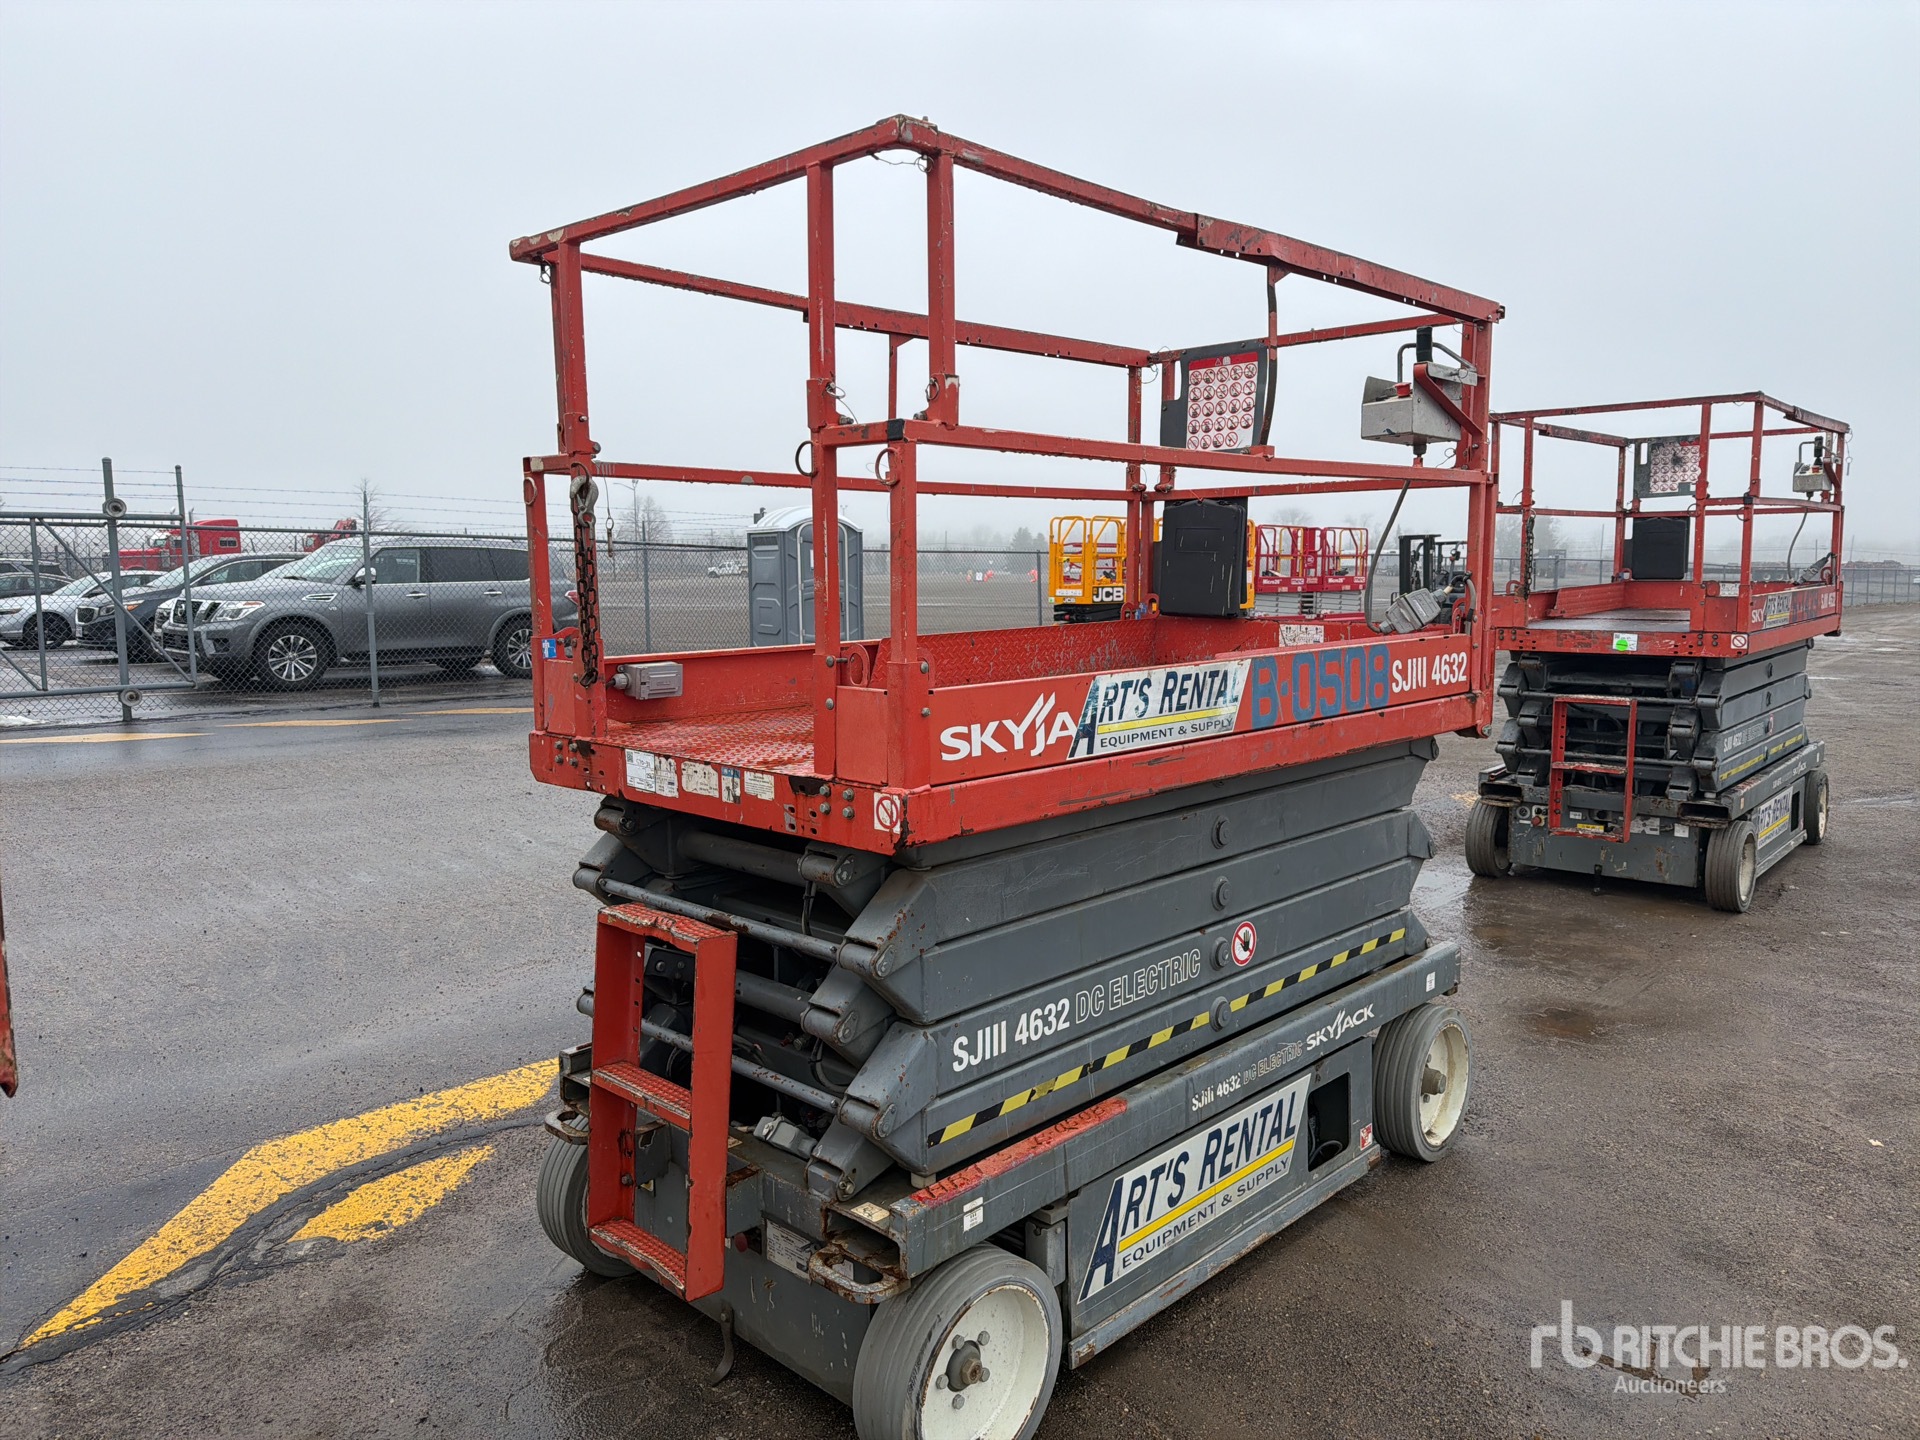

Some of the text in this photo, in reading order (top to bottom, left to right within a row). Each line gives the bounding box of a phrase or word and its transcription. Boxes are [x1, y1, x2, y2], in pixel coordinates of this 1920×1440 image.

[1093, 587, 1124, 602] JCB
[1069, 668, 1239, 758] ART'S RENTAL
[1431, 651, 1467, 686] 4632
[1100, 718, 1233, 747] EQUIPMENT & SUPPLY
[952, 948, 1201, 1072] SJIII 4632 DC ELECTRIC
[1216, 1072, 1242, 1098] 4632
[1257, 1041, 1303, 1077] ELECTRIC
[1306, 1003, 1375, 1051] SKYJACK
[1079, 1091, 1297, 1300] ART'S RENTAL
[1122, 1156, 1289, 1269] EQUIPMENT & SUPPLY
